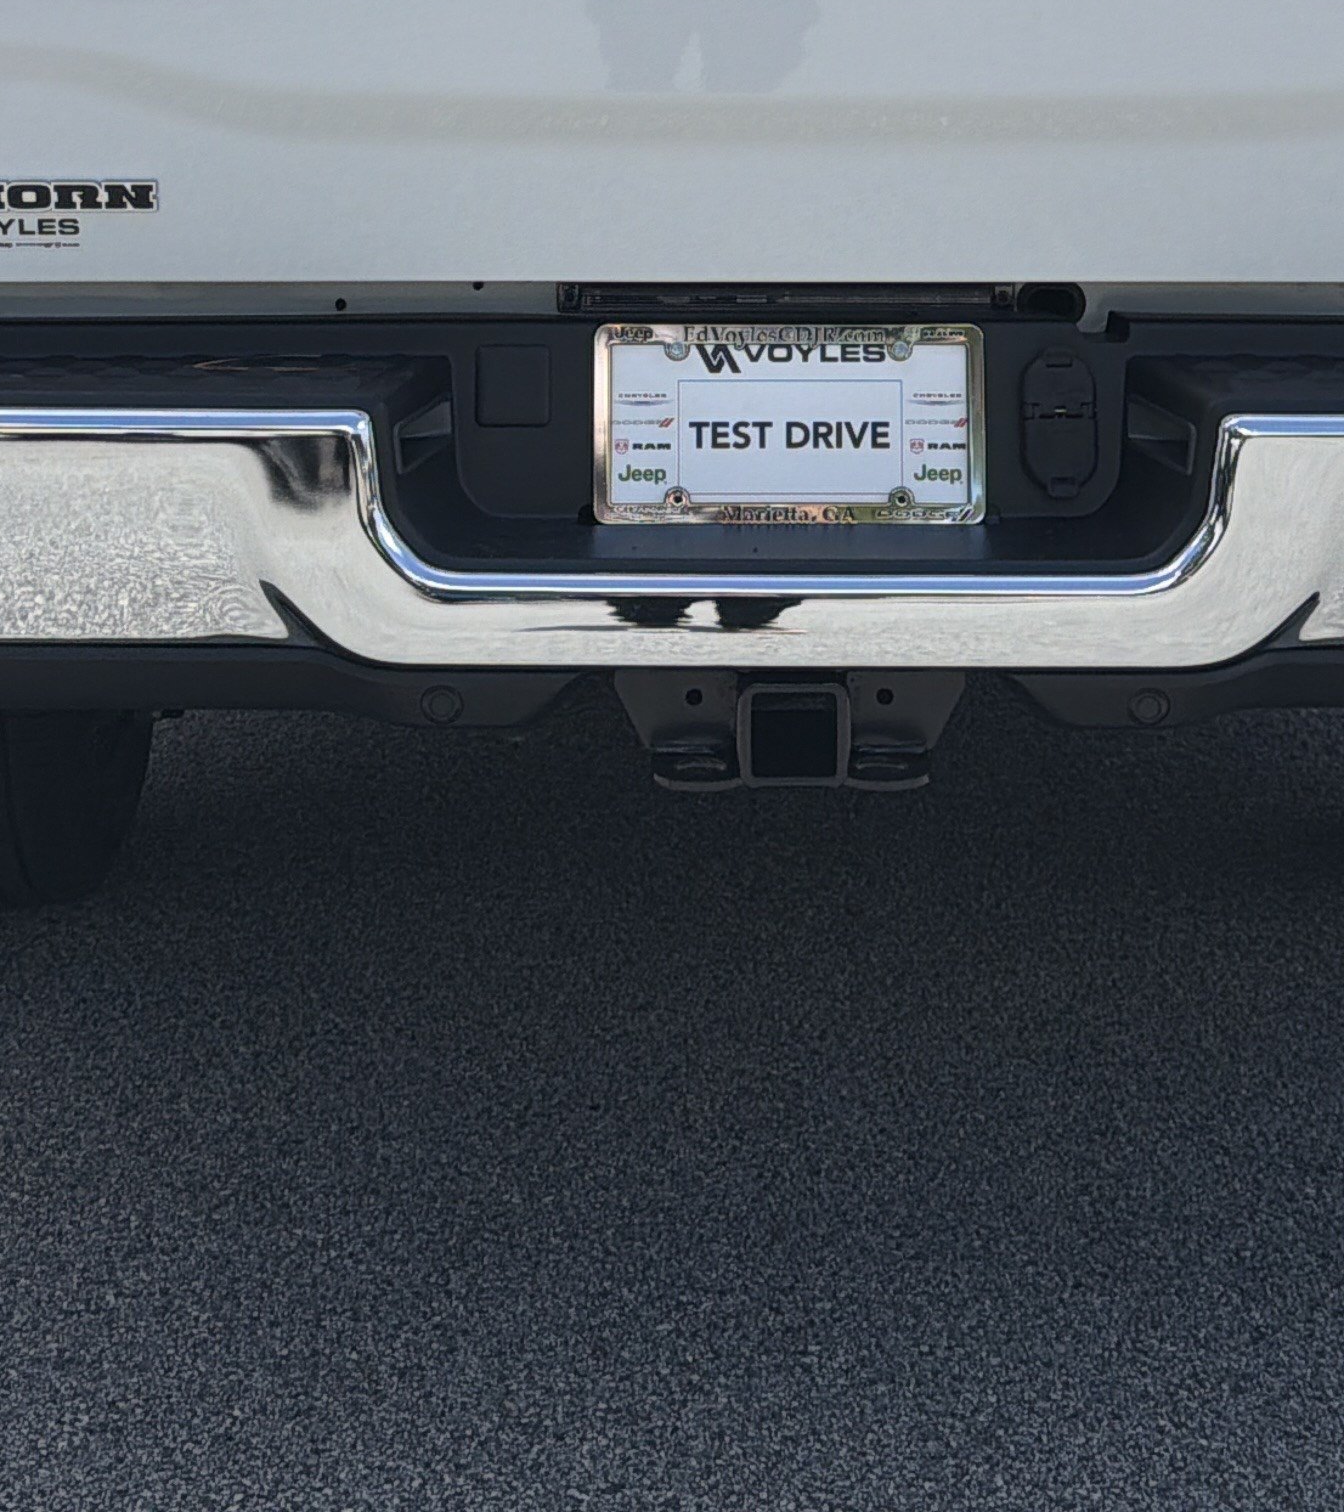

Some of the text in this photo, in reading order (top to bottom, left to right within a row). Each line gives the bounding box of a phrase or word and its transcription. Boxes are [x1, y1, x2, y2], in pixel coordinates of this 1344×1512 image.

[743, 344, 887, 363] VOYLES
[688, 421, 891, 450] TEST DRIVE
[632, 442, 672, 451] RAM
[927, 442, 967, 451] RAM
[618, 464, 667, 486] Jeep
[913, 464, 963, 486] Jeep
[821, 505, 856, 523] GA
